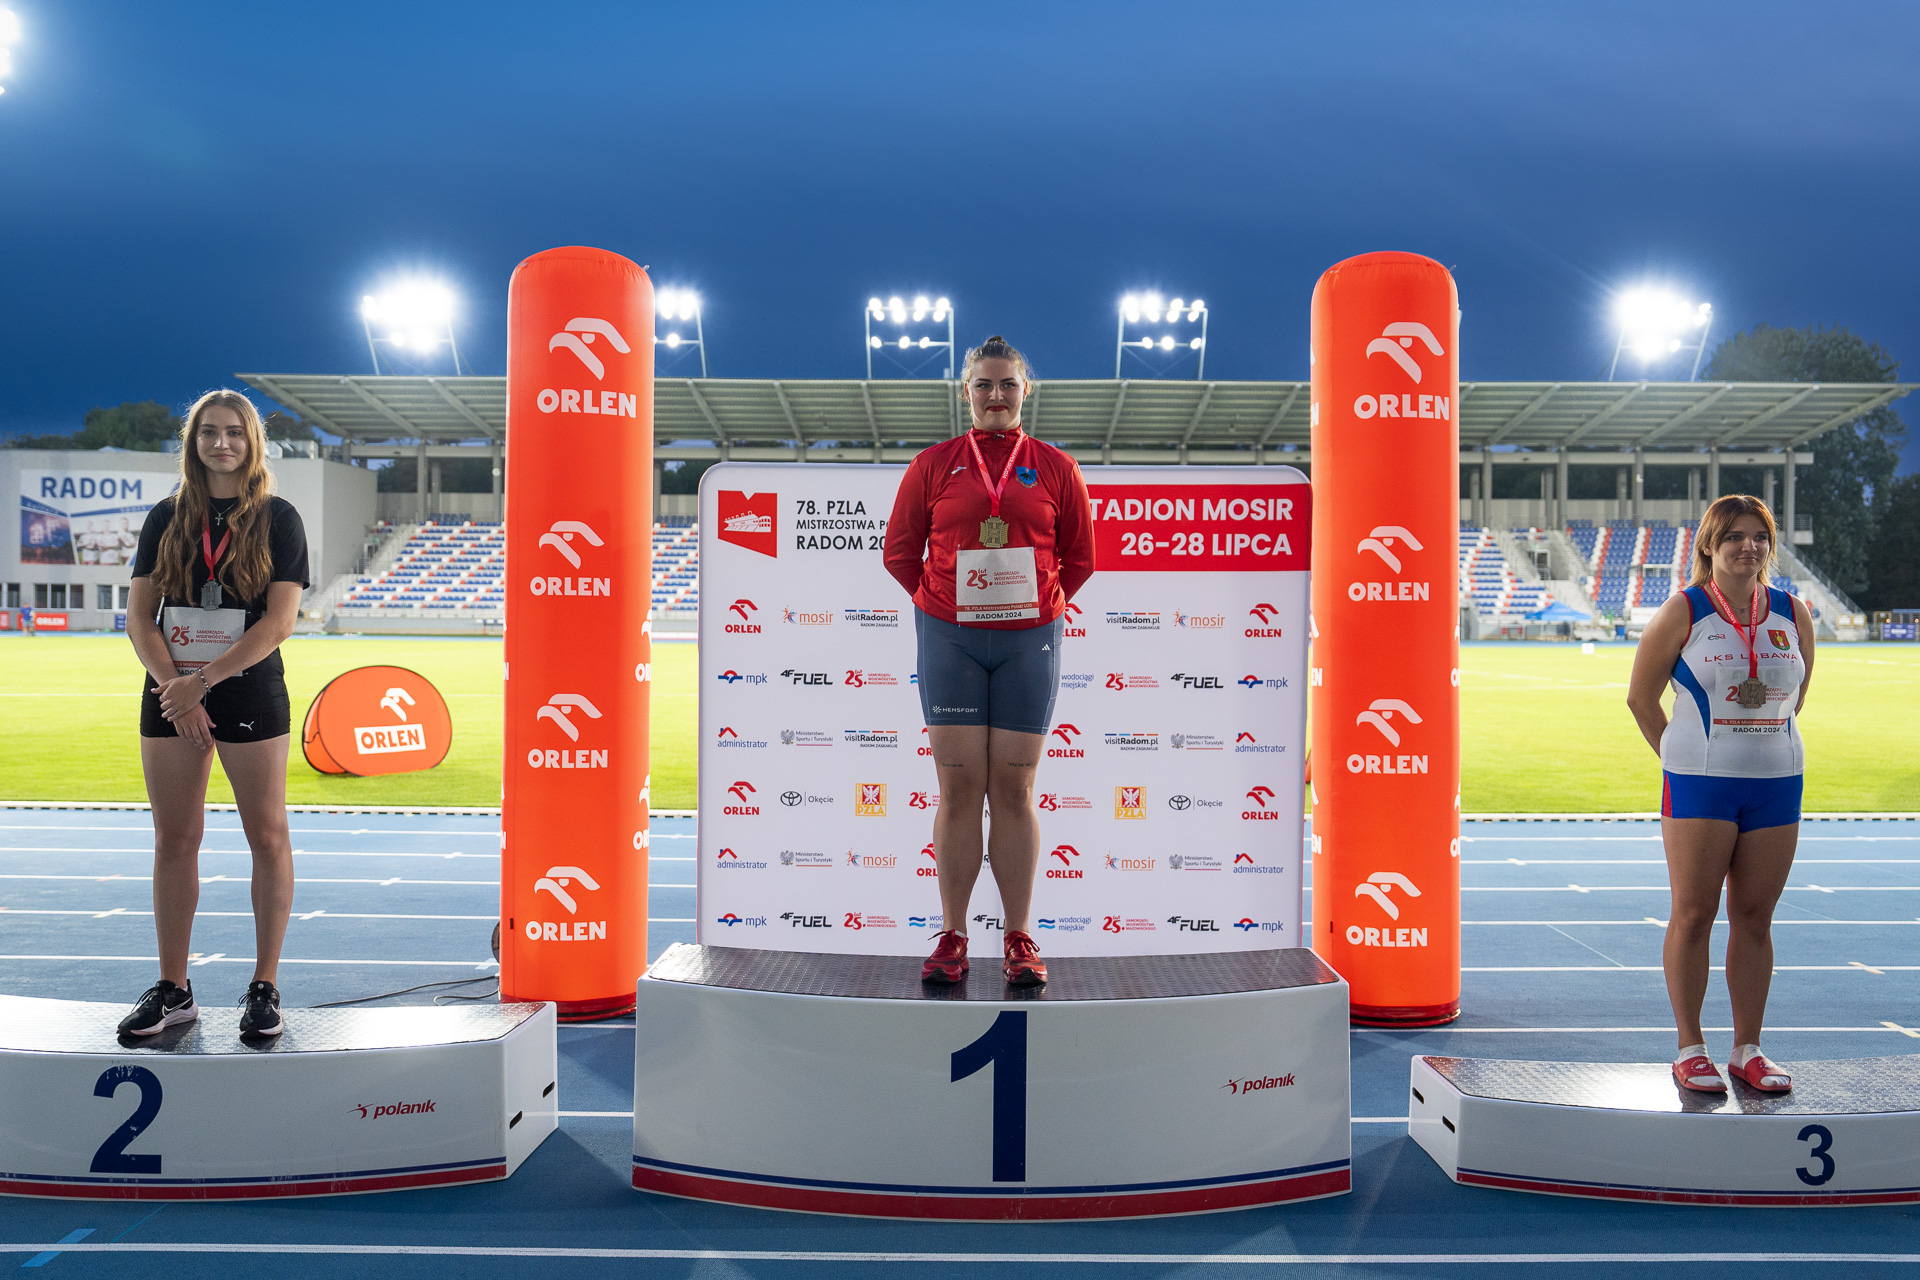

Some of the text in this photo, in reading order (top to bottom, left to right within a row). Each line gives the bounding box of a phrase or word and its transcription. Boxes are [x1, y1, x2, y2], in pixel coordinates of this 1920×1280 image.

[537, 388, 636, 418] ORLEN
[1354, 393, 1449, 421] ORLEN
[41, 476, 142, 499] RADOM
[797, 500, 866, 515] 78. PZLA
[1089, 498, 1293, 521] TADION MOSIR
[796, 520, 875, 530] MISTRZOSTWA
[797, 536, 863, 550] RADOM
[1212, 533, 1293, 556] LIPCA
[530, 576, 611, 597] ORLEN
[1348, 582, 1429, 601] ORLEN
[800, 611, 834, 623] mosir
[845, 614, 898, 623] visitRadom.pl
[1106, 616, 1160, 625] visitRadom.pl
[1191, 614, 1225, 627] mosir
[725, 625, 762, 634] ORLEN
[1062, 628, 1086, 637] LEN
[1245, 629, 1282, 638] ORLEN
[1705, 654, 1734, 663] LKS
[746, 672, 768, 686] mpk
[781, 670, 833, 686] 4F FUEL
[1061, 673, 1095, 682] wodociągi
[1171, 673, 1224, 689] 4F FUEL
[1266, 677, 1288, 690] mpk
[1061, 681, 1088, 690] miejskie
[360, 728, 420, 749] ORLEN
[718, 740, 768, 748] administrator
[845, 734, 898, 743] visitRadom.pl
[1105, 737, 1159, 746] visitRadom.pl
[1047, 749, 1084, 758] ORLEN
[1235, 745, 1286, 753] administrator
[528, 749, 608, 769] ORLEN
[1347, 754, 1428, 774] ORLEN
[808, 796, 834, 804] Okęcie
[1197, 799, 1223, 808] Okęcie
[724, 807, 760, 816] ORLEN
[858, 806, 884, 815] PZLA
[1116, 809, 1144, 818] PZLA
[1242, 811, 1279, 820] ORLEN
[717, 861, 767, 869] administrator
[863, 854, 897, 866] mosir
[1122, 857, 1156, 869] mosir
[917, 868, 939, 877] ORL
[1046, 870, 1083, 879] ORLEN
[1233, 865, 1284, 874] administrator
[746, 915, 767, 929] mpk
[780, 912, 832, 928] 4F FUEL
[1059, 916, 1092, 925] wodociągi
[1167, 916, 1220, 932] 4F FUEL
[526, 920, 607, 942] ORLEN
[1059, 924, 1085, 933] miejskie
[1262, 920, 1284, 934] mpk
[1346, 925, 1428, 947] ORLEN
[1242, 1073, 1296, 1096] polanik
[951, 1010, 1028, 1183] 1
[373, 1100, 436, 1120] polanik
[90, 1065, 163, 1174] 2
[1796, 1124, 1836, 1186] 3
